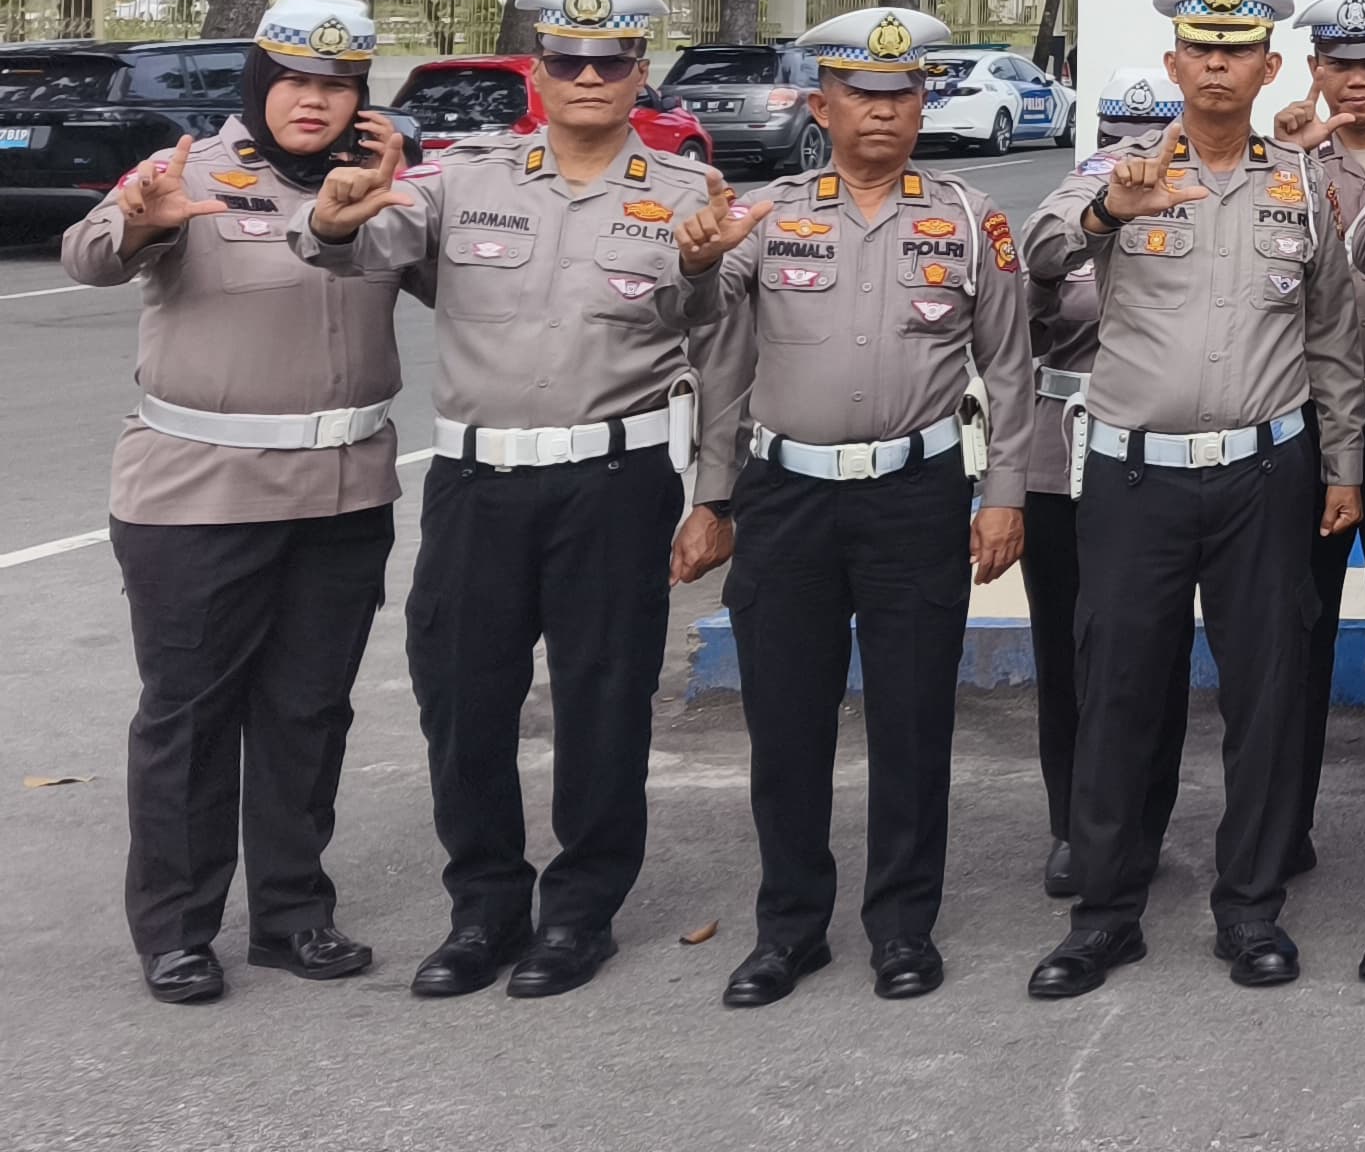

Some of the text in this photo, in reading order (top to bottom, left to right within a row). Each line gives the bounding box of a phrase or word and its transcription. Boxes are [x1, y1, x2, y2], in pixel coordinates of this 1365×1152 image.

[459, 211, 530, 231] DARMAINIL
[1259, 210, 1309, 226] POLR
[611, 222, 675, 245] POLRI
[902, 241, 964, 258] POLRI
